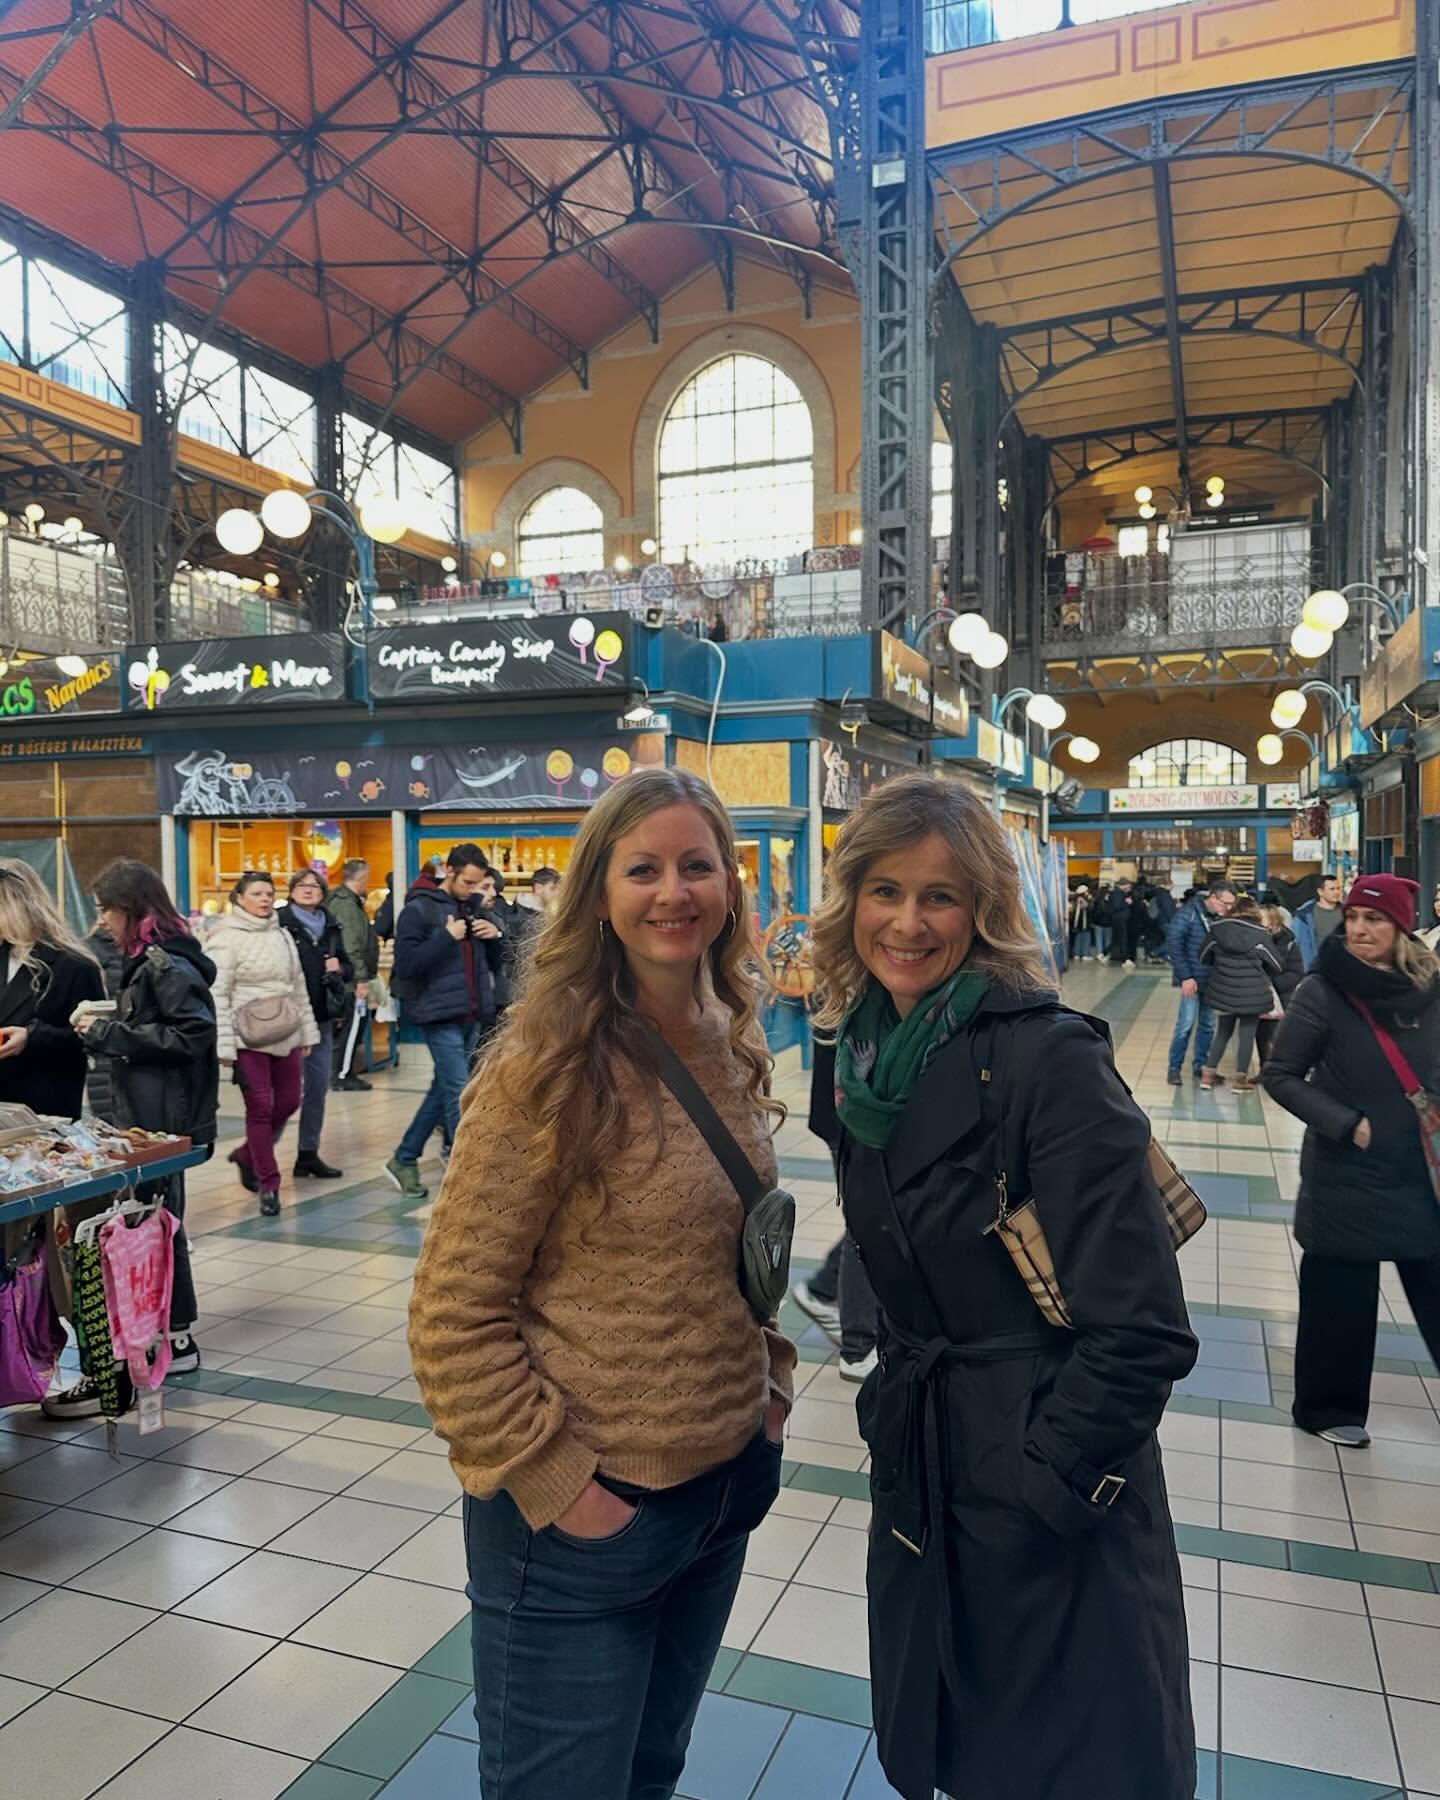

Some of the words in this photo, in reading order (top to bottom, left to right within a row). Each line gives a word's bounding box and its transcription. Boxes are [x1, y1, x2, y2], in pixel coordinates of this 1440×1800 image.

[379, 645, 444, 670] Captain
[449, 640, 506, 667] Candy
[511, 637, 555, 663] Shop
[44, 660, 112, 712] Narancs
[181, 662, 250, 695] Sweet
[251, 664, 269, 688] &
[271, 659, 333, 687] More
[431, 665, 500, 687] Budapest
[0, 676, 35, 716] CS
